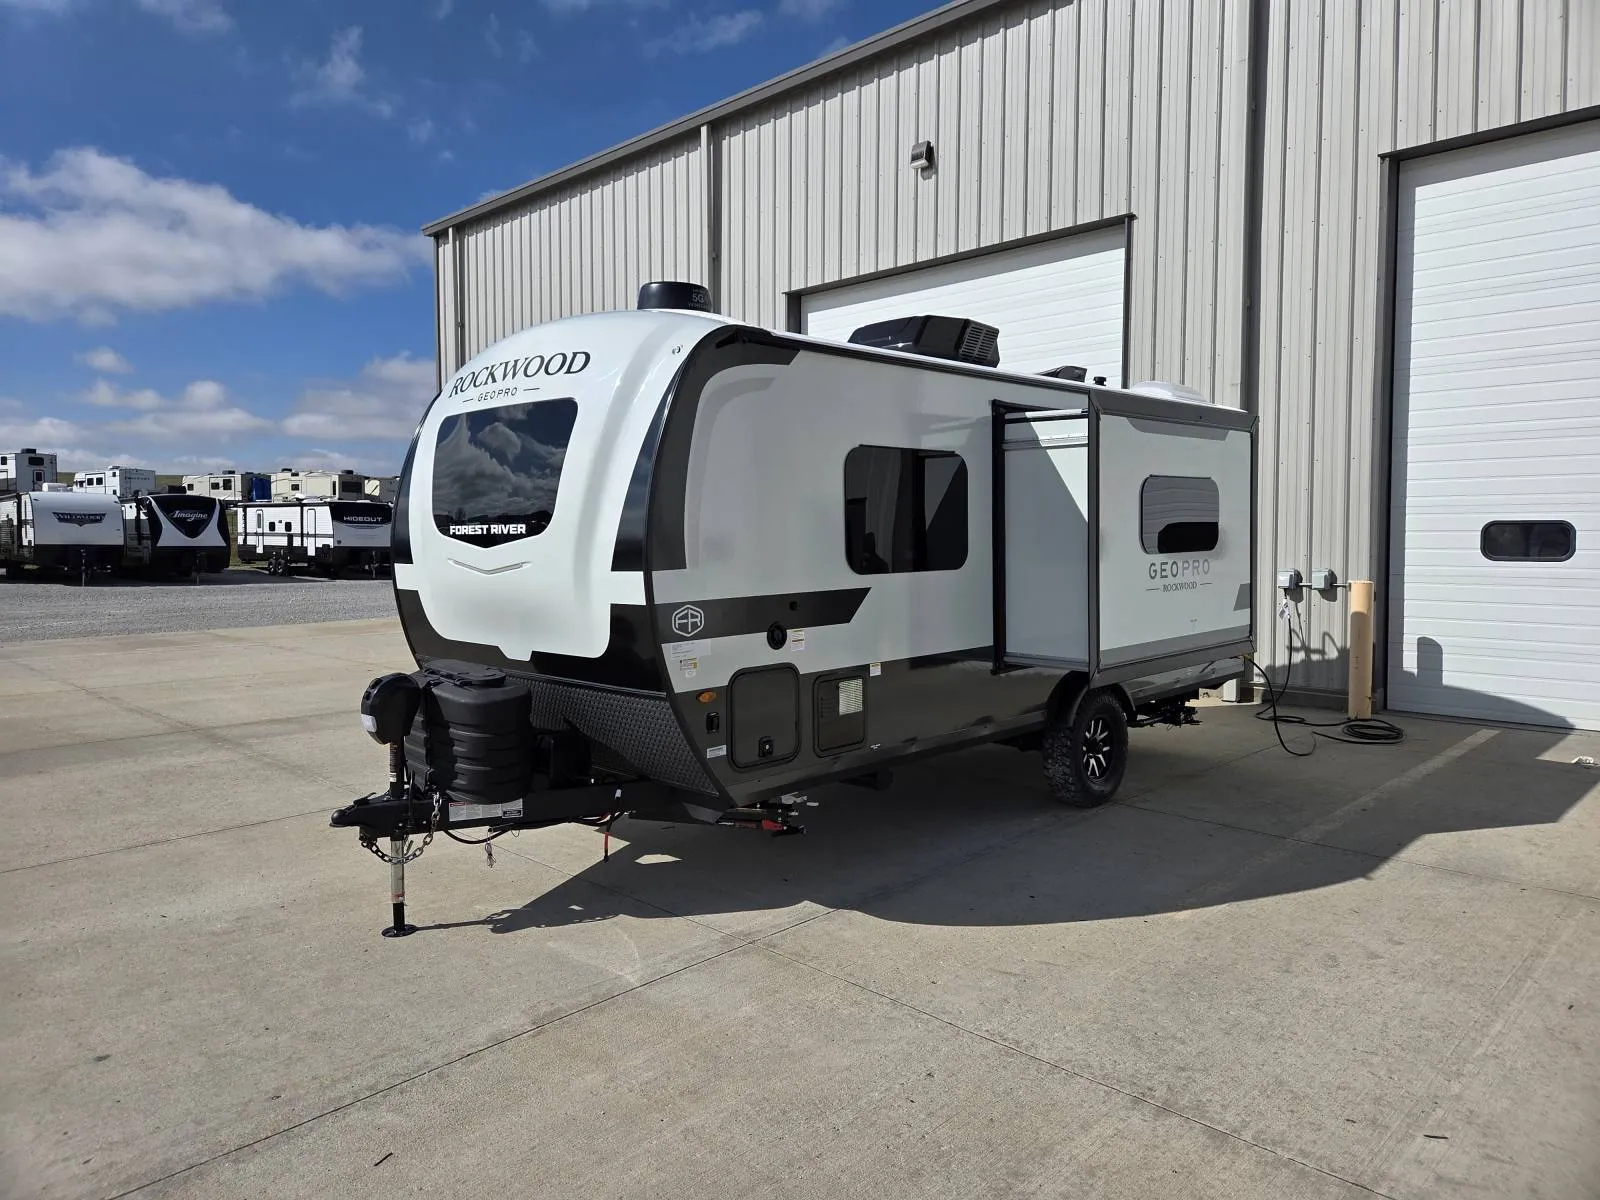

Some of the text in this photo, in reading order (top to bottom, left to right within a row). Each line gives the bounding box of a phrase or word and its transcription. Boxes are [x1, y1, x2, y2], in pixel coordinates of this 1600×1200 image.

[692, 293, 705, 303] 5G
[448, 351, 591, 398] ROCKWOOD
[477, 387, 518, 402] GEOPRO
[170, 510, 208, 522] Imagine
[449, 523, 526, 535] FOREST RIVER
[1148, 559, 1210, 580] GEOPRO
[1162, 581, 1198, 592] ROCKWOOD
